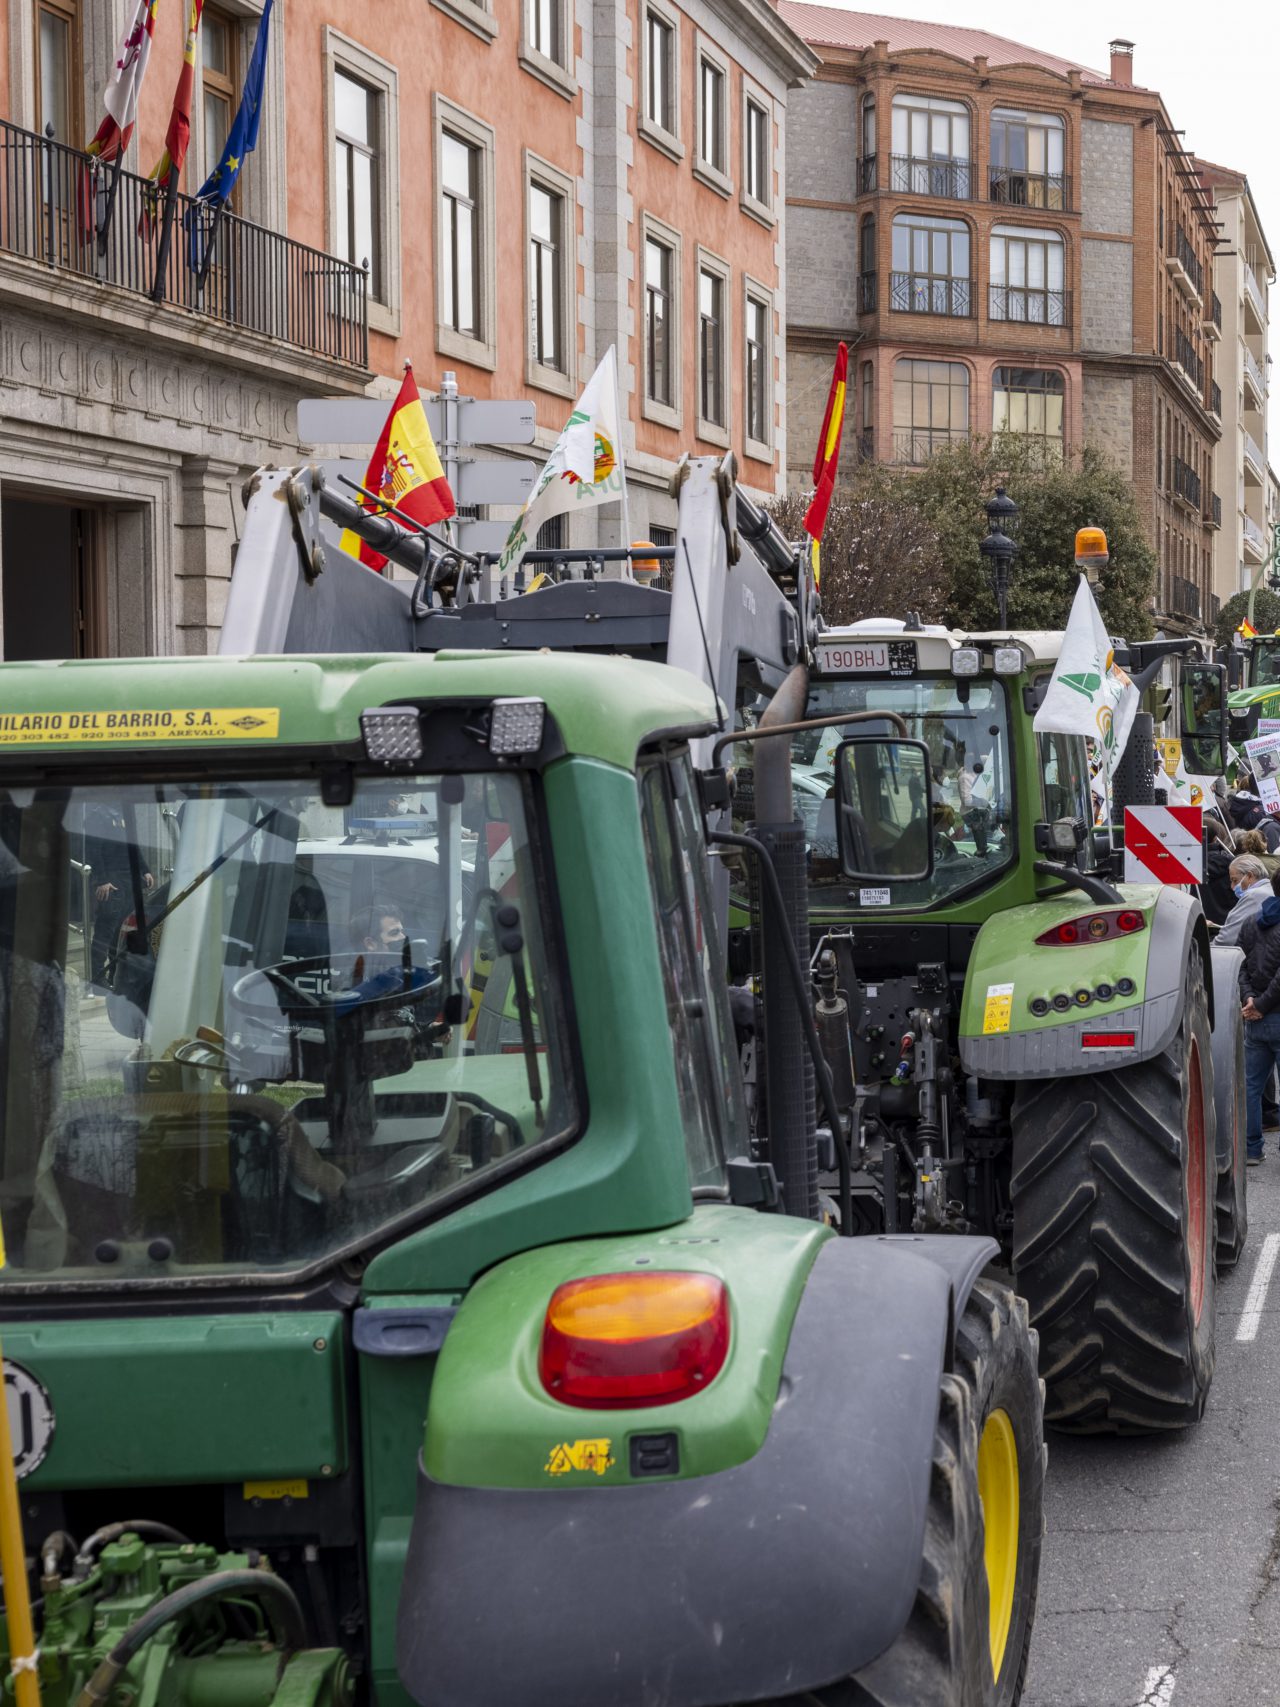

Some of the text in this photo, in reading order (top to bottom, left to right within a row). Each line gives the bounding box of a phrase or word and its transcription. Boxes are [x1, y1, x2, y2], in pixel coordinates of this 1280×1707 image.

[824, 649, 885, 668] 190BHJ
[69, 713, 100, 729] DEL
[106, 711, 177, 729] BARRIO,
[184, 711, 218, 727] S.A.
[168, 728, 226, 737] ARÉVALO
[1266, 801, 1280, 812] NO
